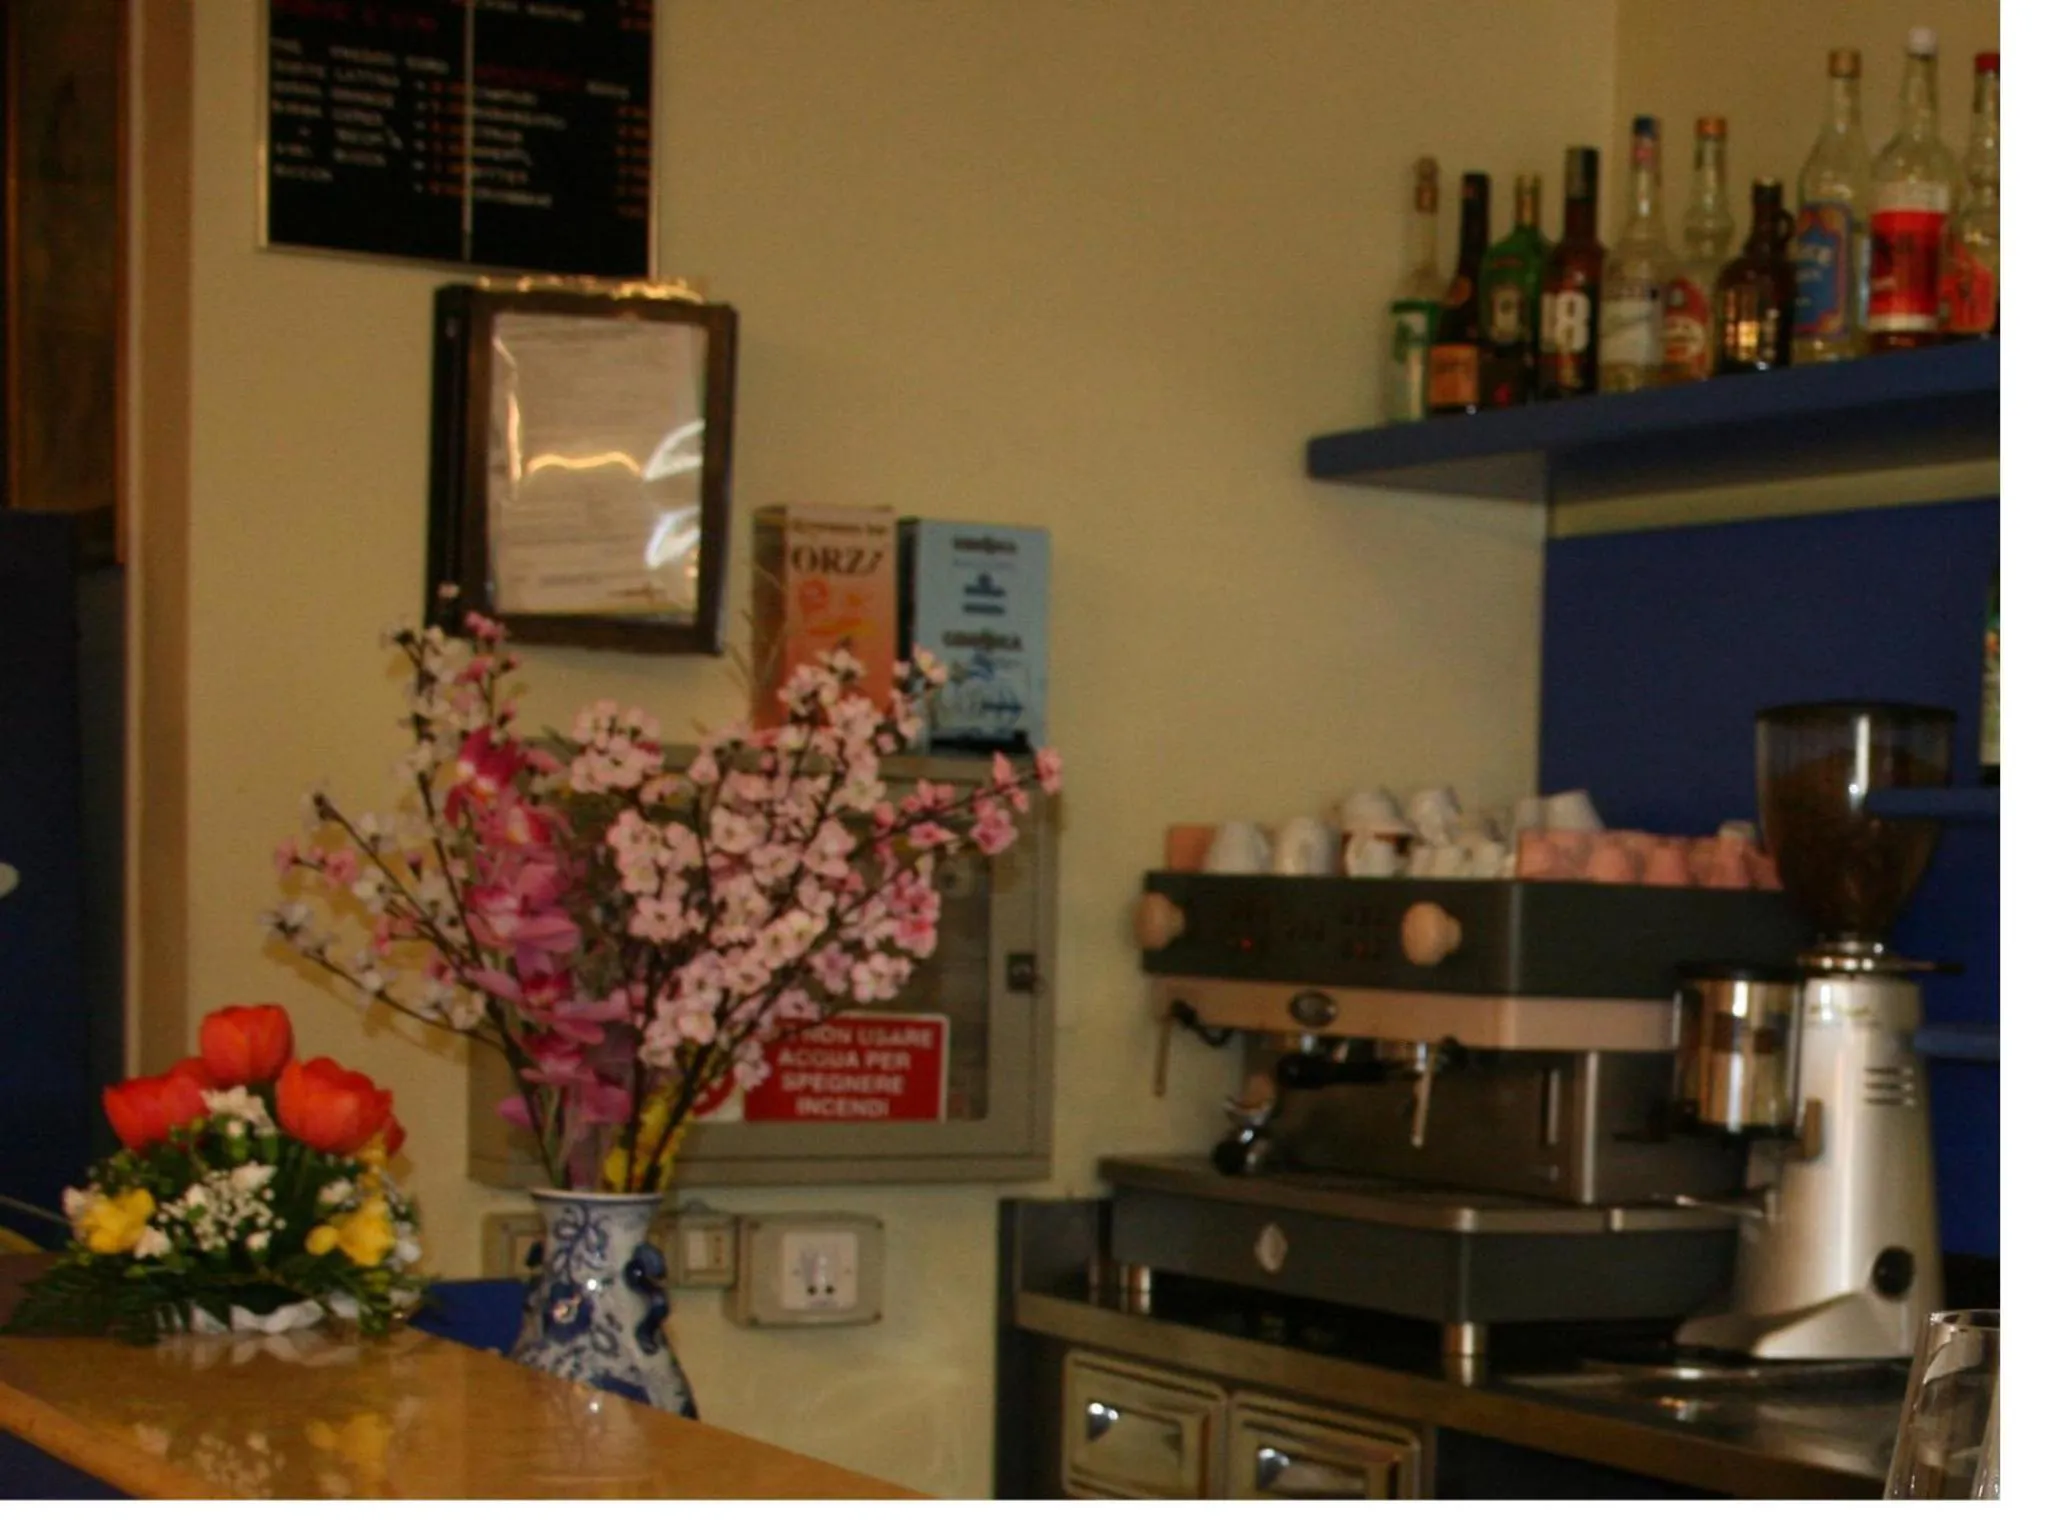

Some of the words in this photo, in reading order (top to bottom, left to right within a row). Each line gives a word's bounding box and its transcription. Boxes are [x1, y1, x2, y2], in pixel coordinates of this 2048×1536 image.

[800, 1026, 852, 1045] NON
[856, 1027, 934, 1048] USARE
[776, 1049, 861, 1068] ACQUA
[865, 1051, 911, 1070] PER
[780, 1073, 905, 1094] SPEGNERE
[795, 1097, 890, 1117] INCENDI
